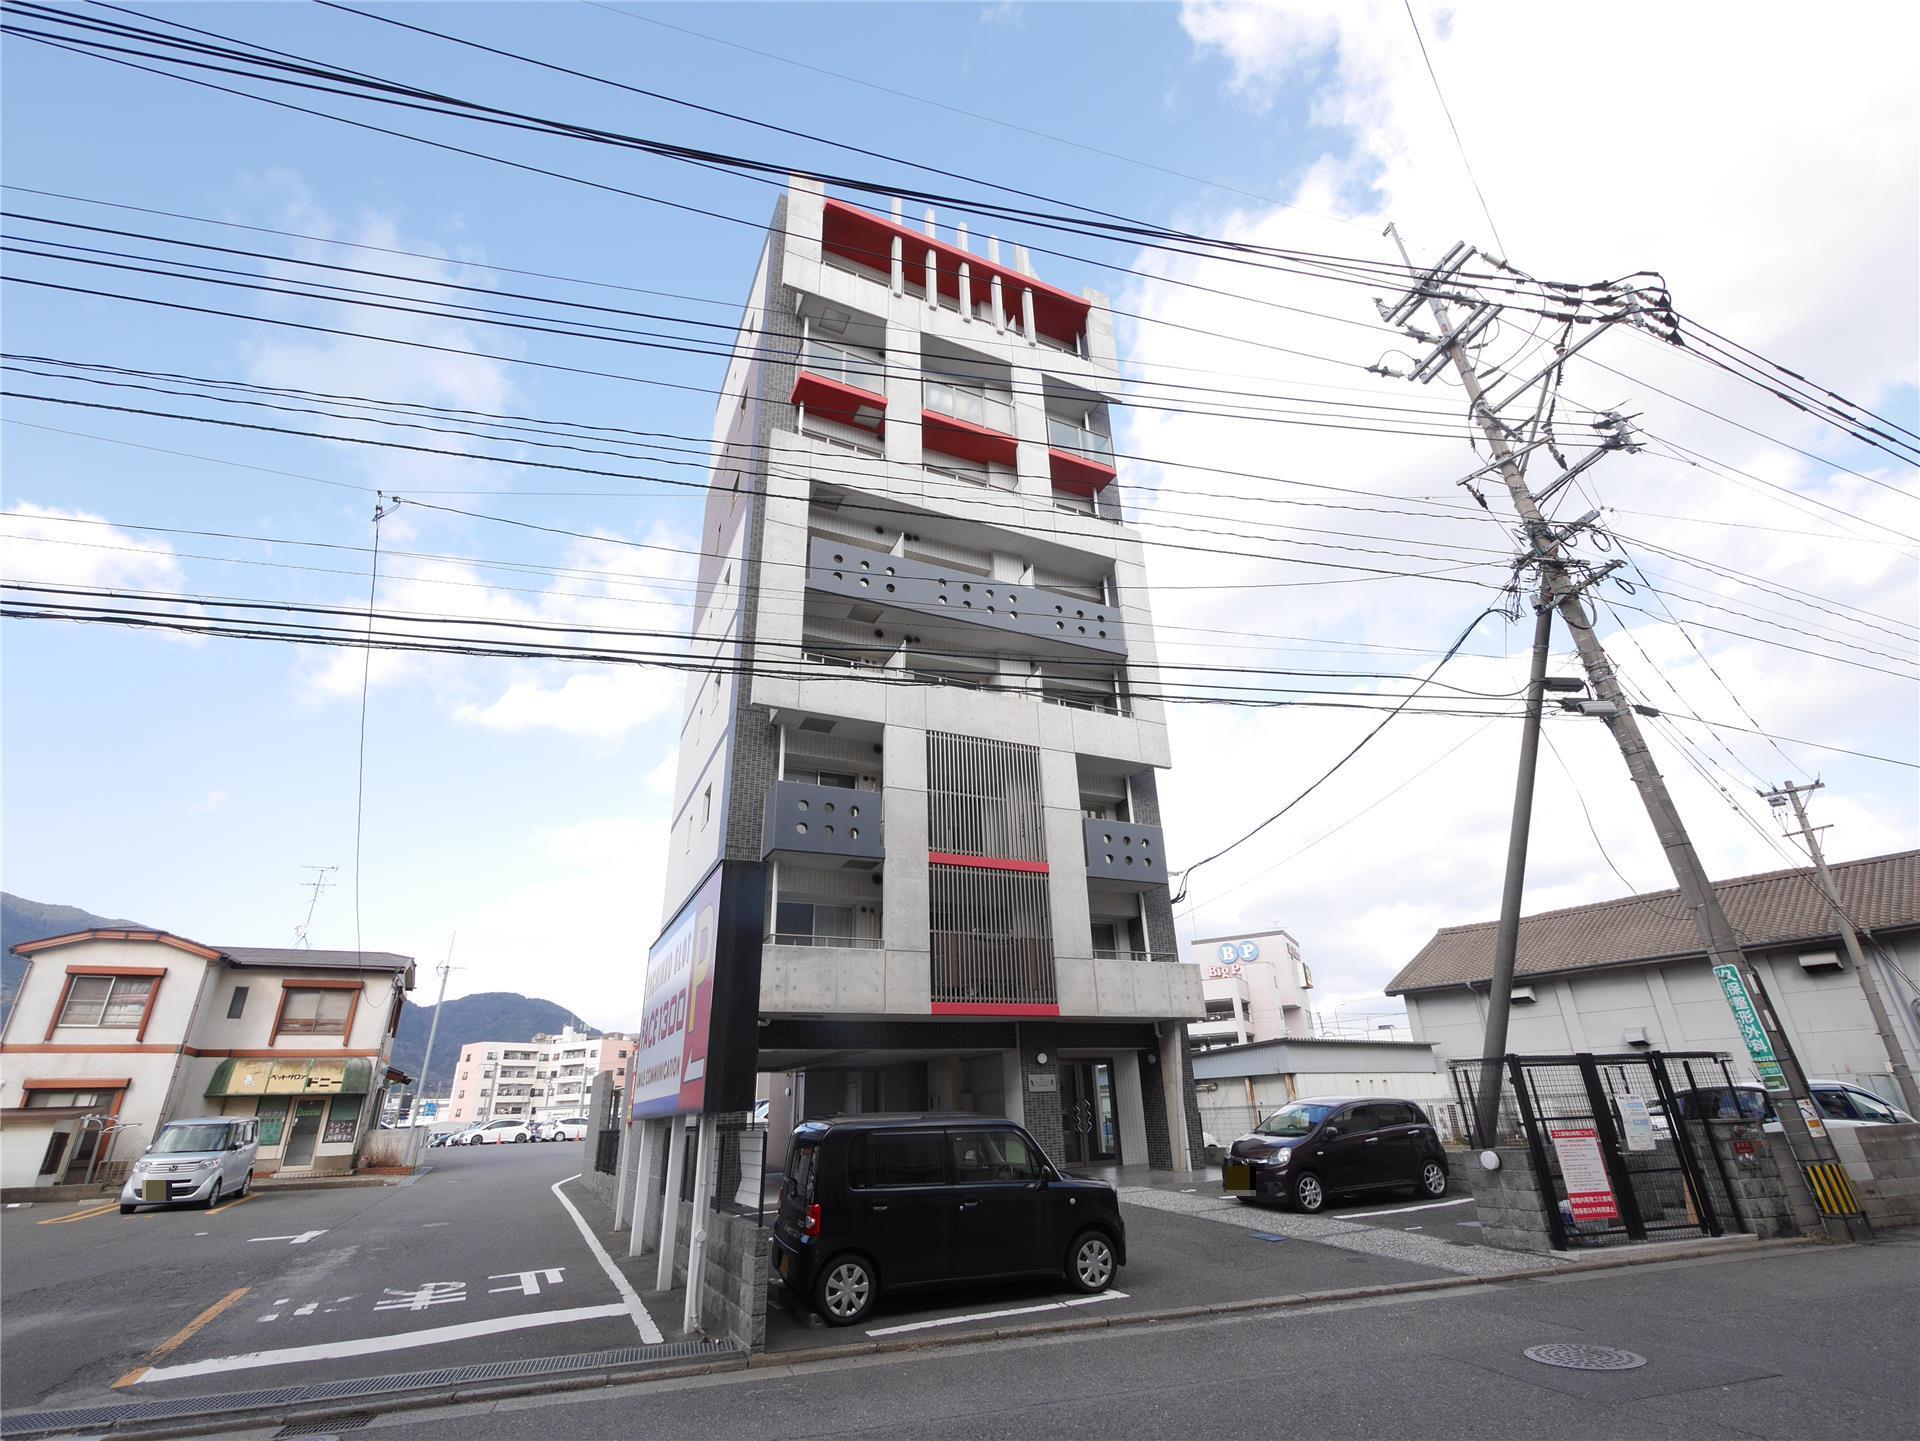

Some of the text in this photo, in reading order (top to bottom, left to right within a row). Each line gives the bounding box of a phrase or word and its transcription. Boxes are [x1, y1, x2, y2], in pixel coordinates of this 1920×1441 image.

[674, 933, 692, 975] SLOT
[688, 903, 714, 1035] P
[1208, 965, 1230, 978] Big
[640, 988, 687, 1053] FACE1300
[1719, 968, 1768, 1053] 久保整形外科
[270, 1073, 343, 1088] ペットサロン ドニー
